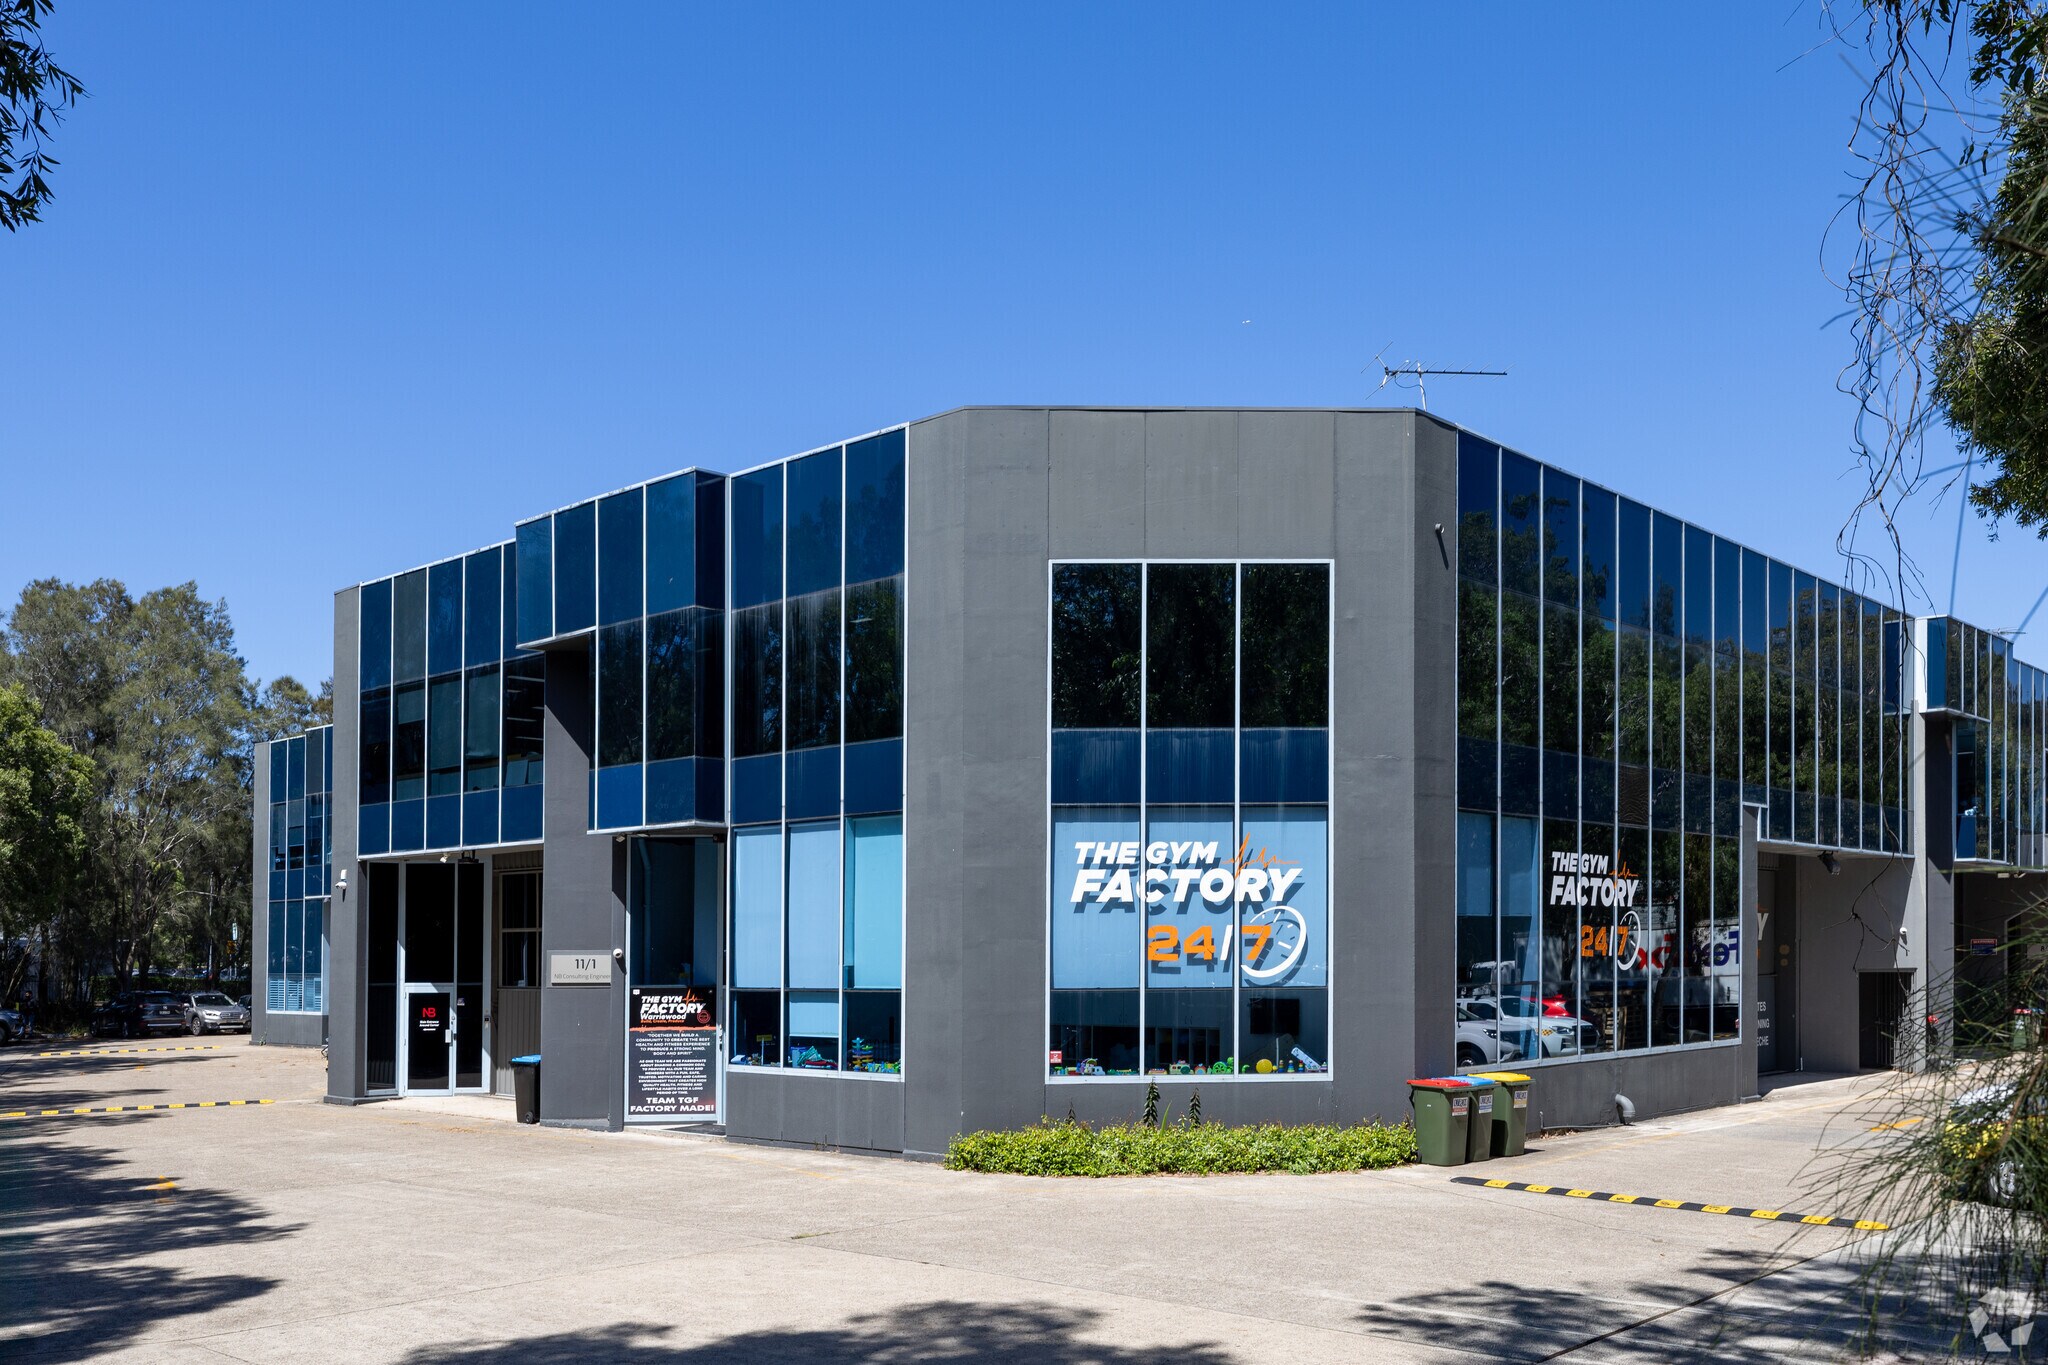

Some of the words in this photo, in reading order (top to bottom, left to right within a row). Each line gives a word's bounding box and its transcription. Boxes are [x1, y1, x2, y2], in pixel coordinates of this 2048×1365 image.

[1074, 842, 1140, 864] THE
[1146, 842, 1218, 864] GYM
[1552, 851, 1578, 872] THE
[1582, 853, 1609, 875] GYM
[1070, 868, 1303, 903] FACTORY
[1550, 875, 1640, 907] FACTORY
[1148, 924, 1272, 962] 24/7
[1581, 924, 1629, 957] 24/7
[575, 959, 596, 970] 11/1
[422, 1008, 436, 1017] NB
[640, 1003, 706, 1013] FACTORY
